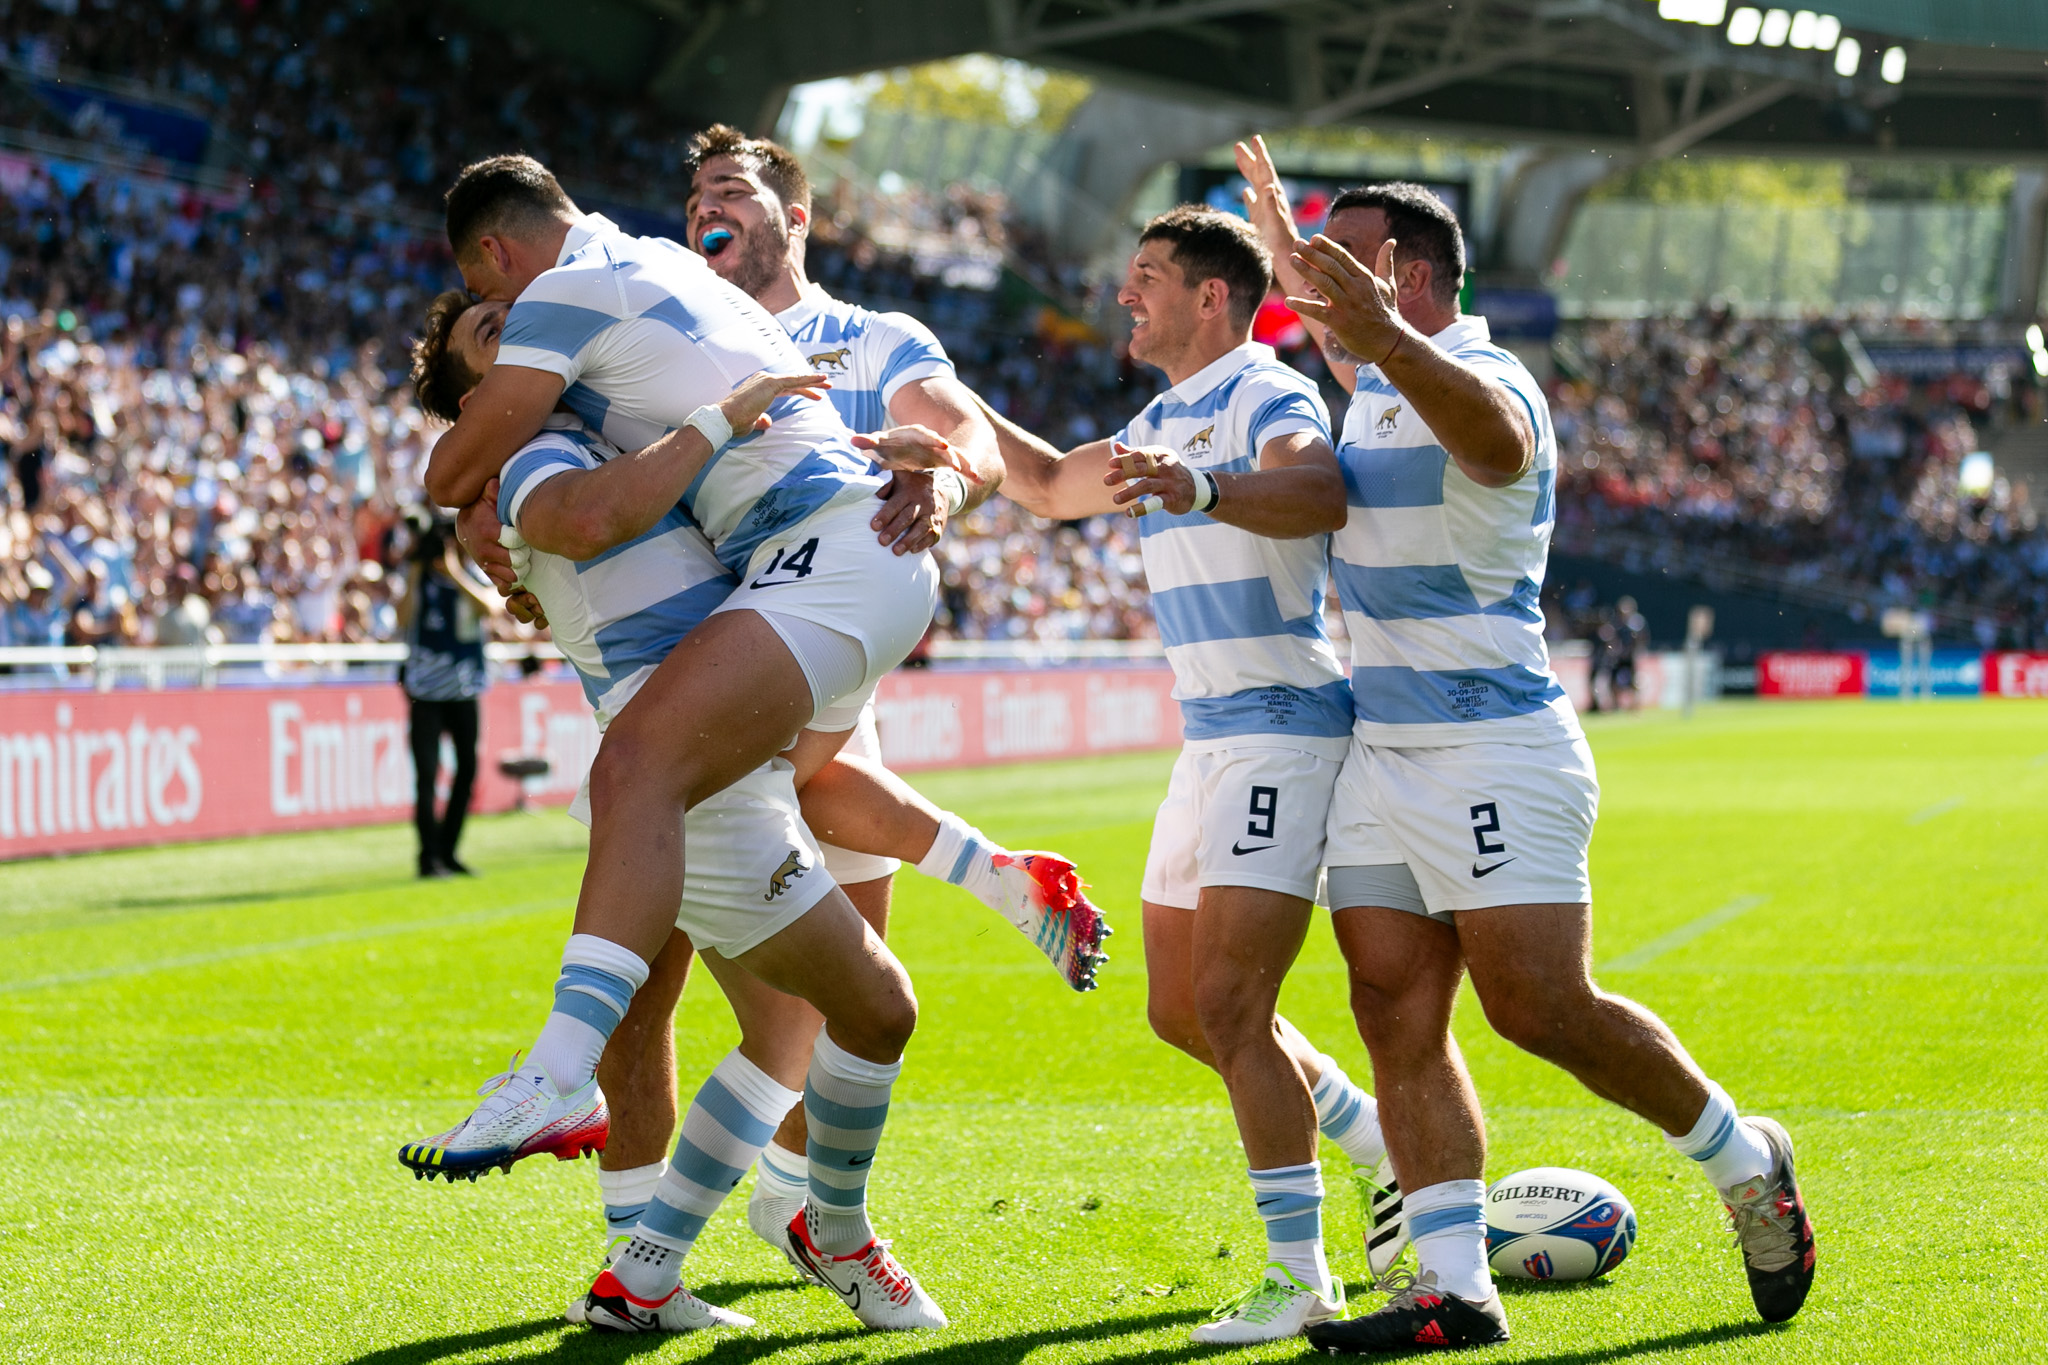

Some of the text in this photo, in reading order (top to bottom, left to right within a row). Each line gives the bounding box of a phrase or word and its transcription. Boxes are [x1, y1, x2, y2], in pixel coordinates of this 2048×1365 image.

[764, 537, 819, 578] 14
[1447, 686, 1488, 696] 30-09-2023
[1458, 680, 1475, 689] CHILE
[1456, 695, 1481, 704] NANTES
[0, 700, 202, 838] mirates
[1247, 786, 1278, 839] 9
[1470, 802, 1505, 855] 2
[1492, 1186, 1585, 1203] GILBERT
[1415, 1335, 1449, 1345] adidas
